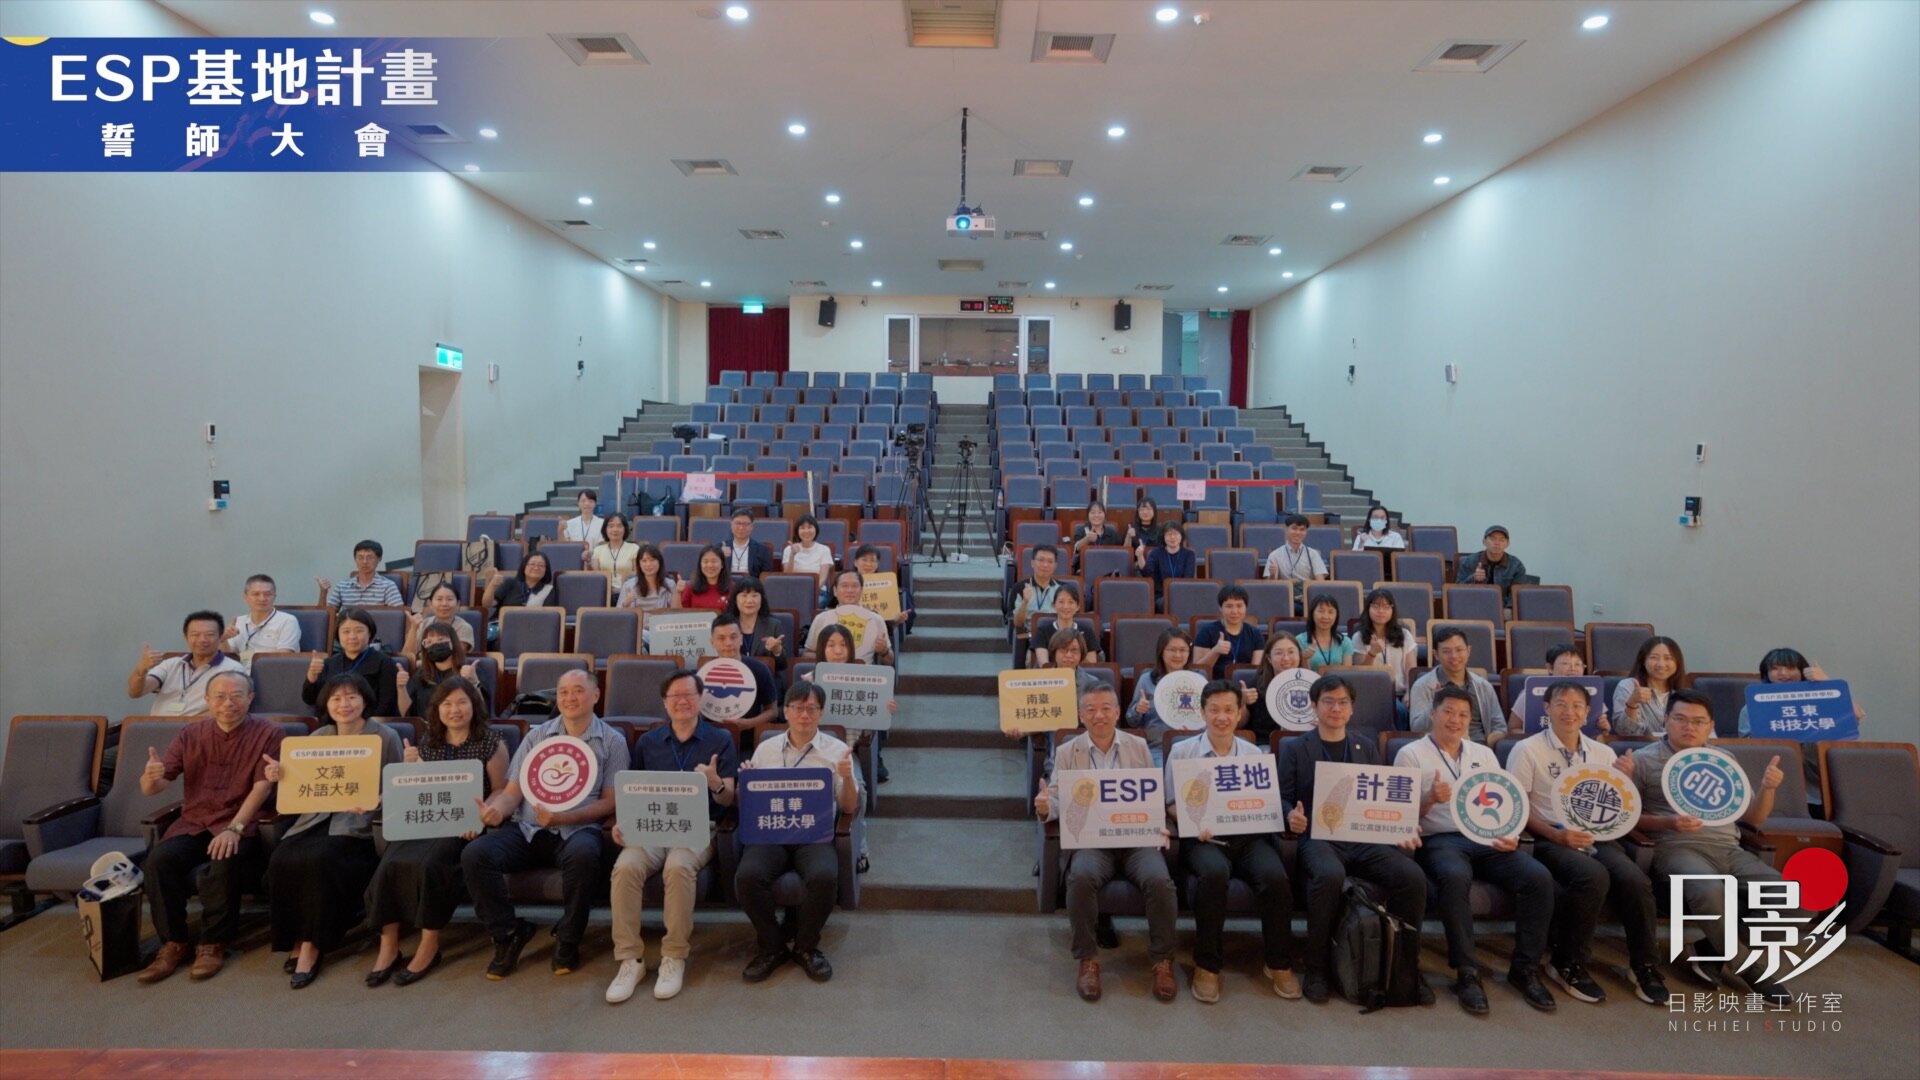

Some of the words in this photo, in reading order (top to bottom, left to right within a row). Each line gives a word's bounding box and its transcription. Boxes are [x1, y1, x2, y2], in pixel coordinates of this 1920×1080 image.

[831, 688, 879, 702] 國立臺中
[1026, 693, 1050, 705] 南臺
[830, 703, 878, 717] 科技大學
[1015, 706, 1062, 719] 科技大學
[1781, 704, 1819, 718] 亞東
[1769, 717, 1836, 732] 科技大學
[315, 765, 345, 780] 文藻
[1214, 762, 1272, 793] 基地
[298, 782, 360, 798] 外語大學
[1100, 778, 1158, 803] ESP
[1356, 772, 1414, 804] 計畫
[418, 791, 452, 806] 朝陽
[770, 797, 803, 813] 龍華
[404, 807, 465, 824] 科技大學
[648, 801, 679, 816] 中臺
[636, 818, 692, 833] 科技大學
[757, 814, 816, 830] 科技大學
